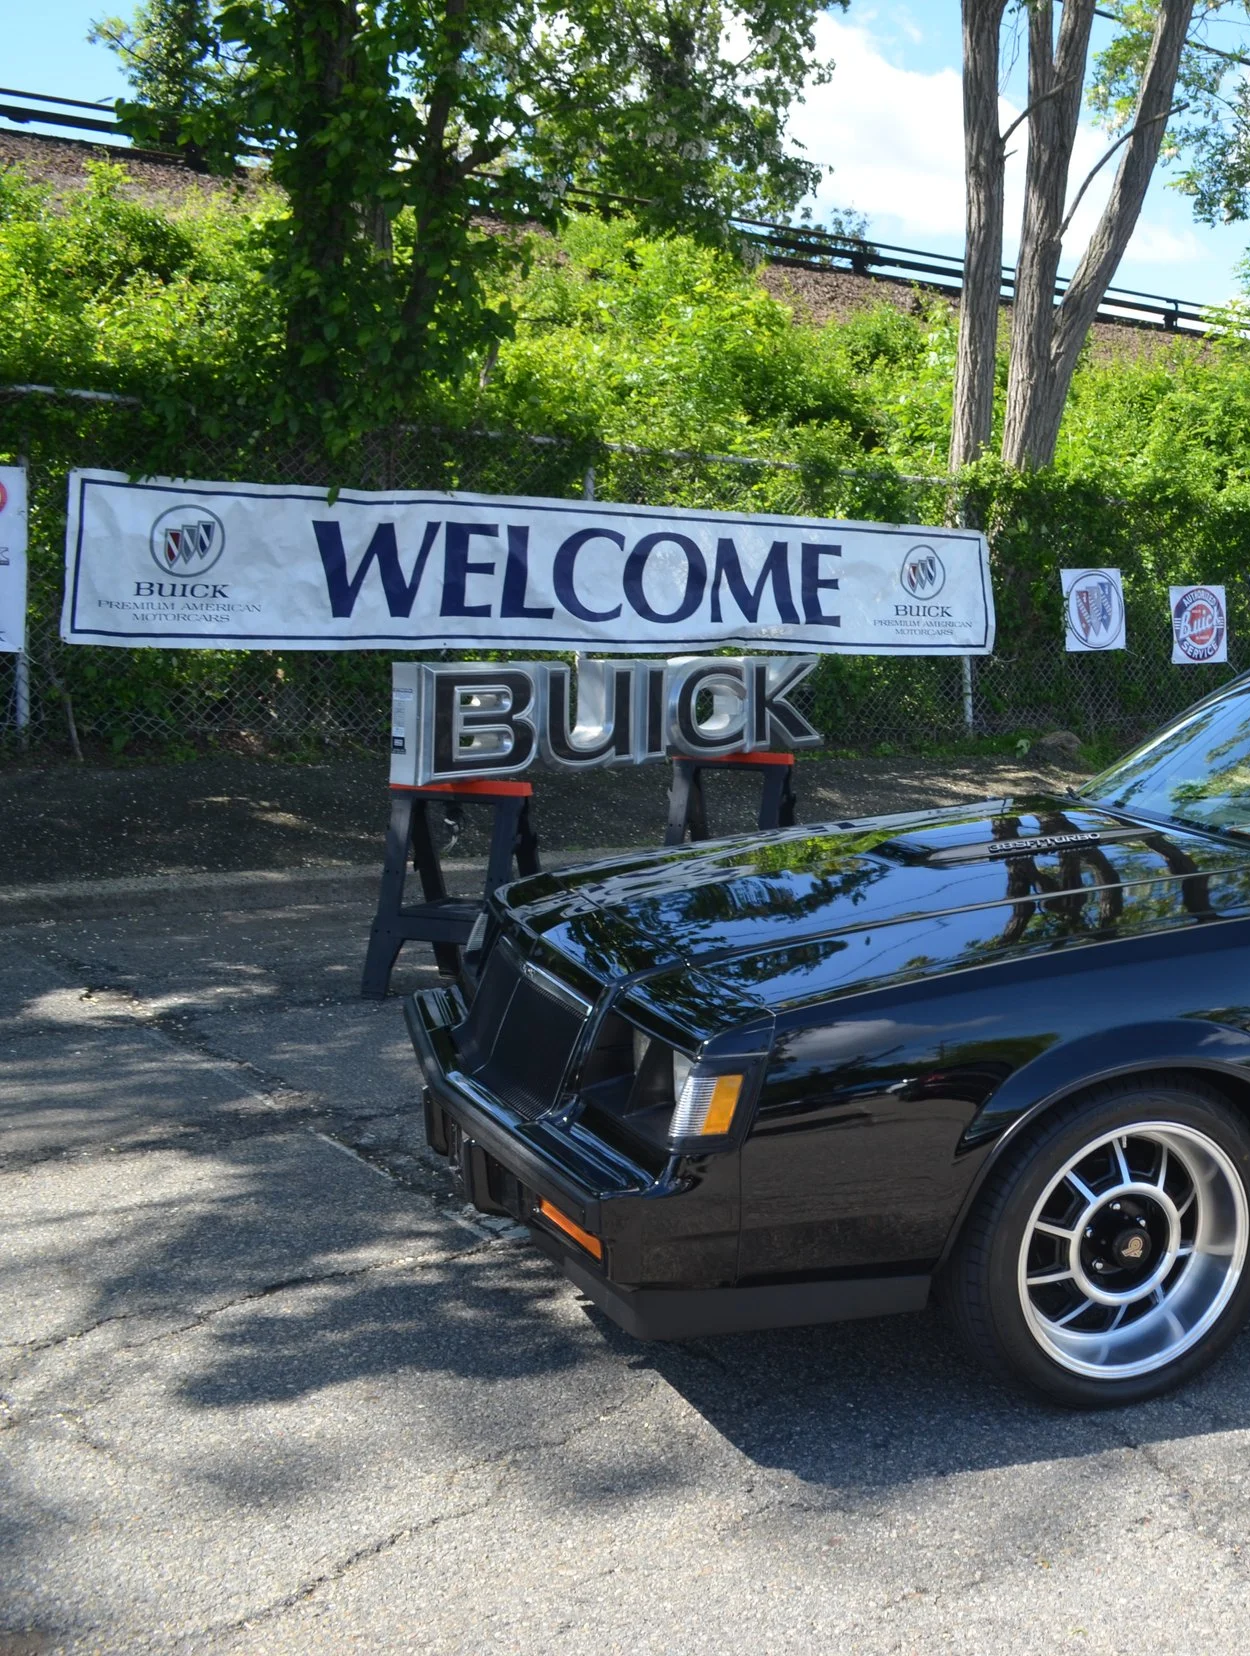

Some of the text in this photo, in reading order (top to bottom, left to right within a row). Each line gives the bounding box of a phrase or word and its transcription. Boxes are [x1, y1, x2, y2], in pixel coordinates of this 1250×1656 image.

[312, 519, 842, 628] WELCOME
[133, 581, 230, 599] BUICK
[98, 600, 262, 613] PREMIUM AMERICAN
[894, 604, 954, 618] BUICK
[132, 612, 230, 623] MOTORCARS
[873, 619, 973, 629] PREMIUM AMERICAN
[1178, 604, 1220, 640] Buick
[895, 628, 954, 636] MOTORCARS
[1180, 641, 1219, 659] SERVICE
[420, 656, 825, 785] BUICK
[1043, 832, 1100, 843] TURBO
